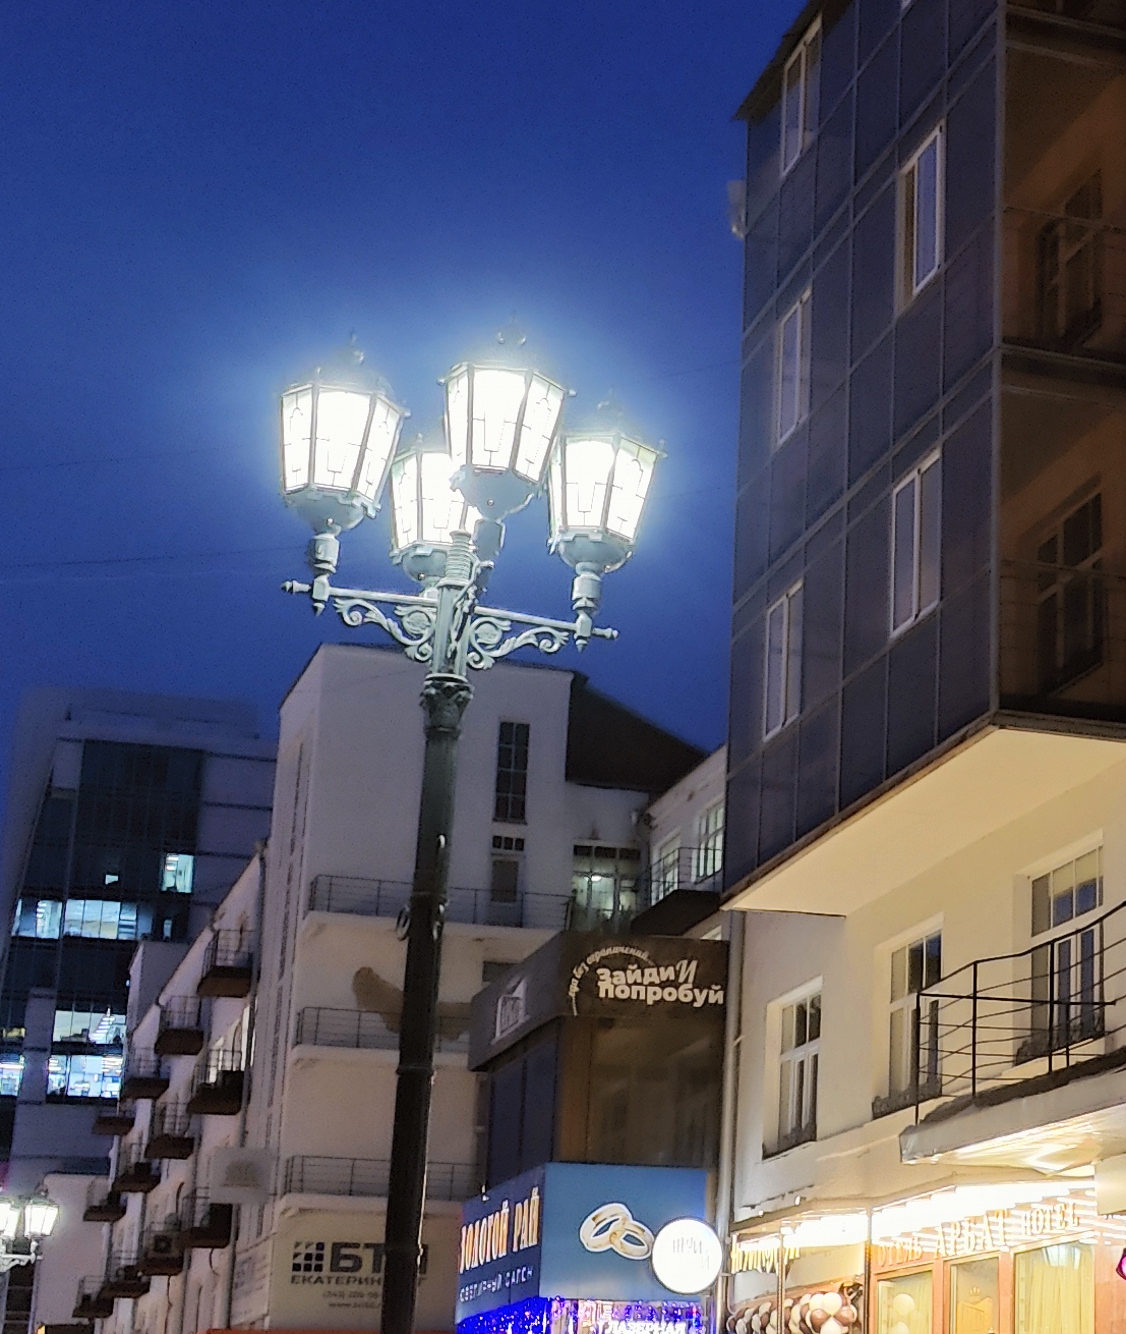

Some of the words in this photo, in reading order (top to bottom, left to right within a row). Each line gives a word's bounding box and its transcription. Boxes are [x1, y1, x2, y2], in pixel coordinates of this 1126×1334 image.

[596, 964, 675, 985] Зайди
[512, 1186, 540, 1253] РАЙ
[878, 1236, 923, 1267] ОТЕЛЬ
[933, 1208, 1012, 1260] АРБАТ
[1021, 1202, 1080, 1236] HOTEL
